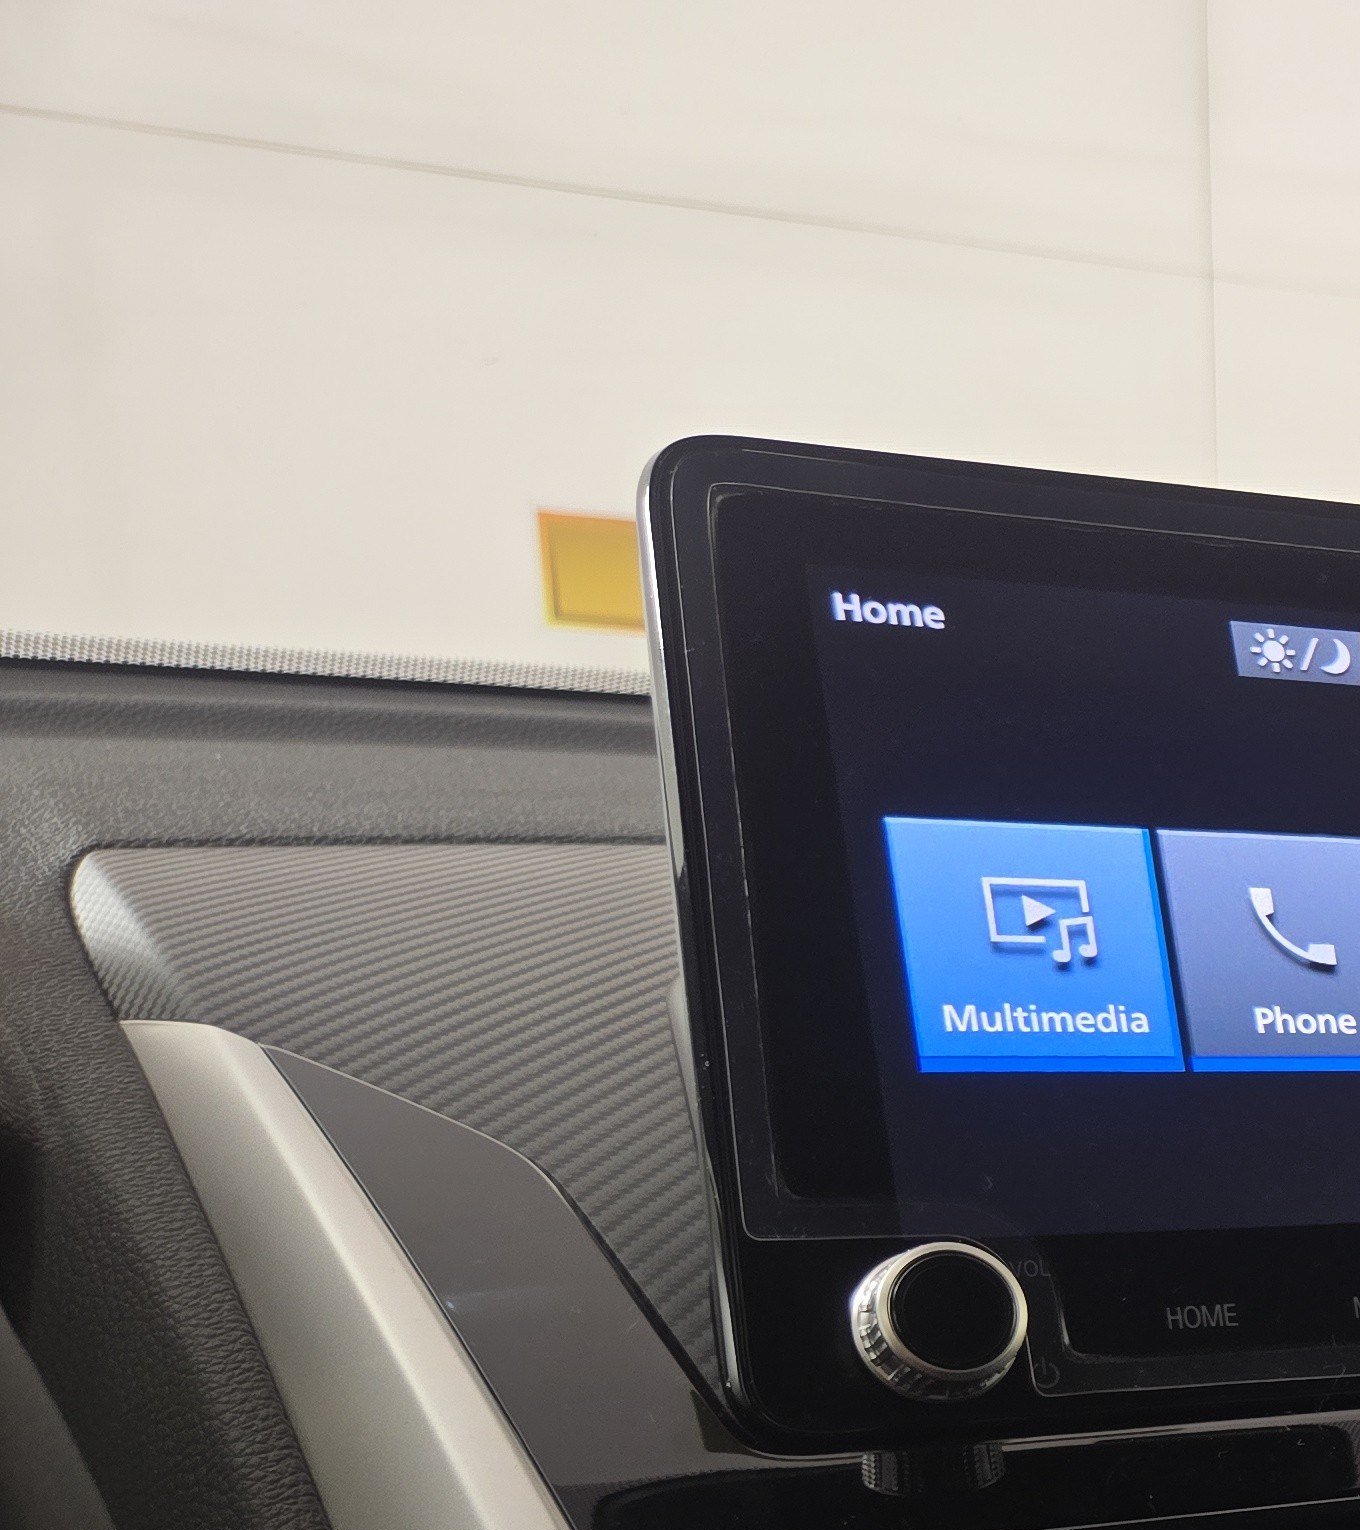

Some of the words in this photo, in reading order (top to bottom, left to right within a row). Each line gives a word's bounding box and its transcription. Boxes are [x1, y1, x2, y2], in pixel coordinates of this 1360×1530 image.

[831, 591, 945, 631] Home
[941, 1002, 1151, 1036] Multimedia
[1253, 1004, 1358, 1038] Phone
[1165, 1302, 1240, 1331] HOME
